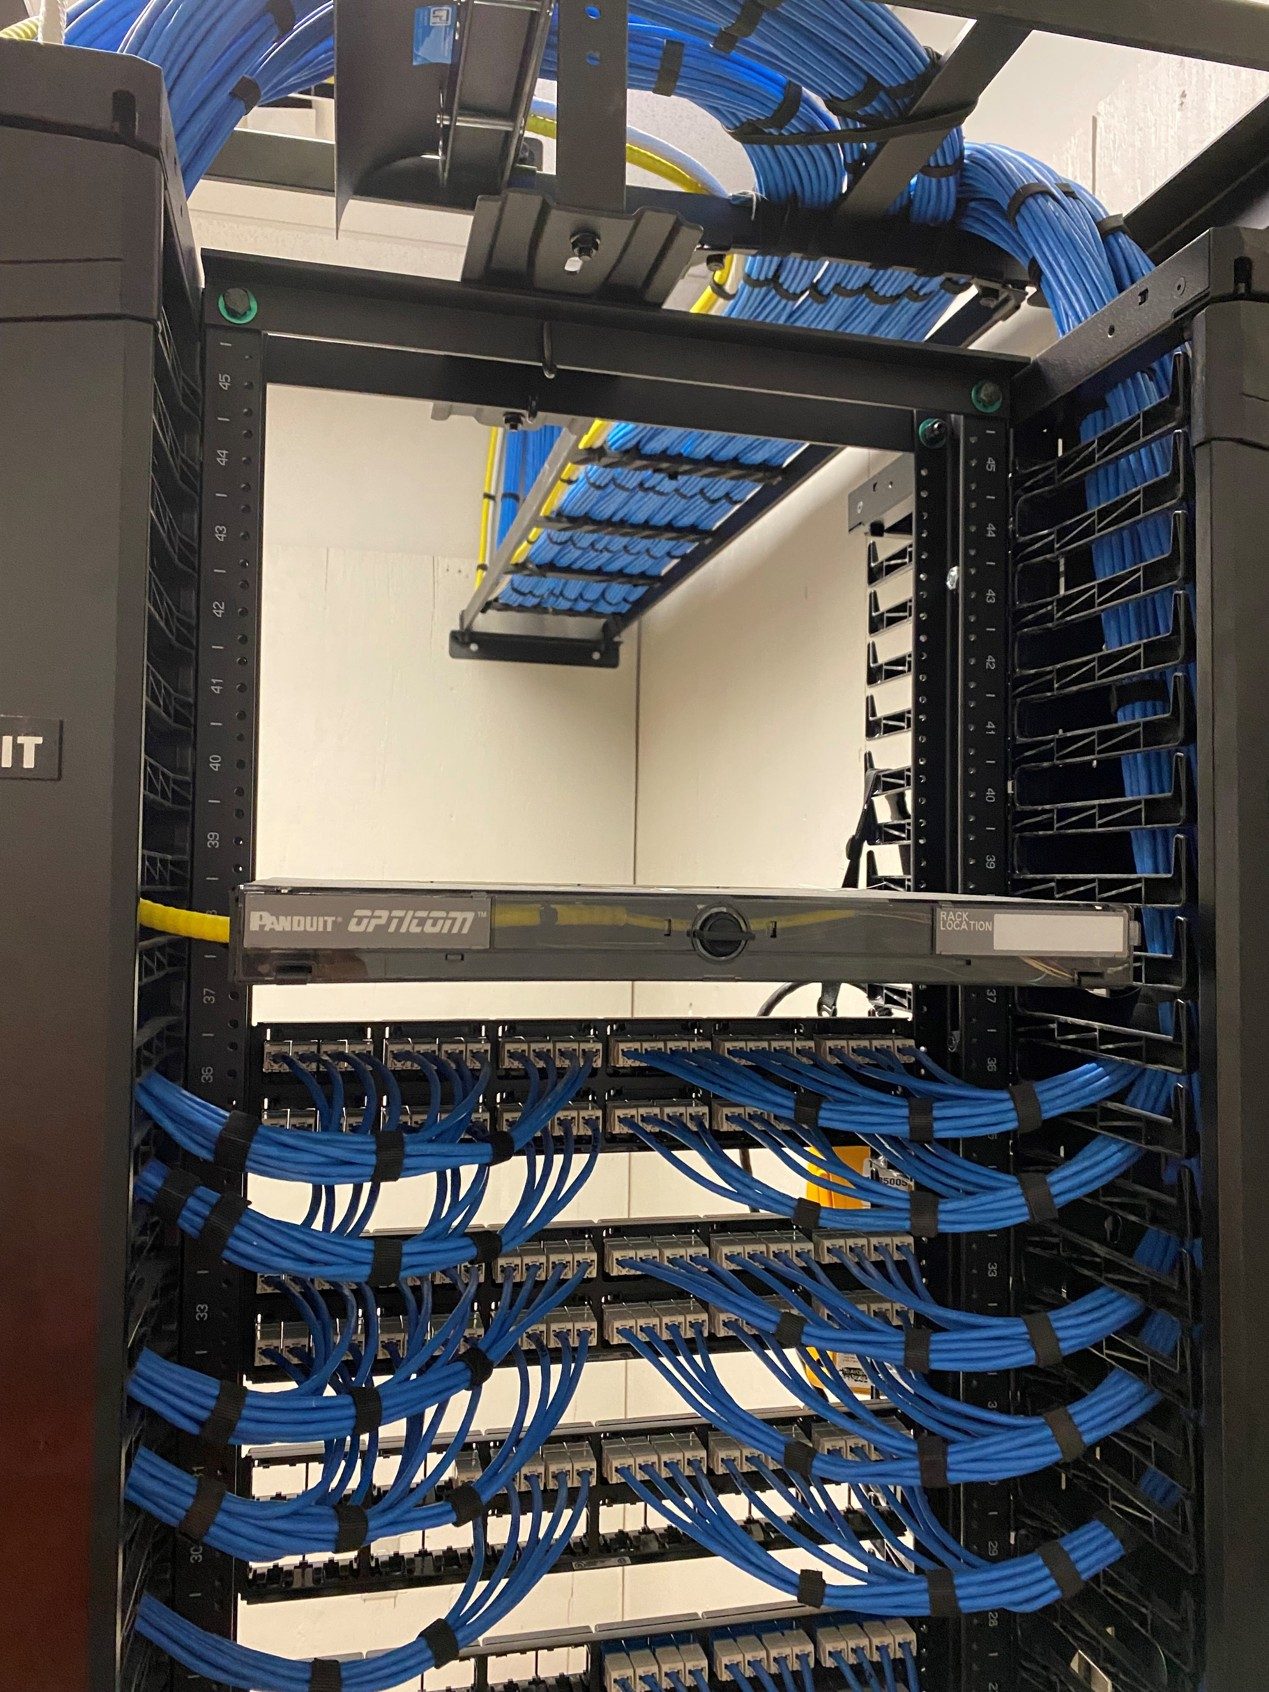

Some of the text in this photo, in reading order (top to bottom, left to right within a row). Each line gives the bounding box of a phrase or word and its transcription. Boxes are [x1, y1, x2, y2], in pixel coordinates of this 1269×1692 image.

[218, 373, 232, 391] 45
[216, 449, 230, 466] 44
[986, 456, 997, 472] 45
[214, 525, 228, 542] 43
[986, 522, 997, 538] 44
[986, 588, 997, 604] 43
[212, 600, 226, 618] 42
[985, 654, 996, 671] 42
[210, 678, 224, 694] 41
[985, 720, 996, 736] 41
[209, 754, 222, 772] 40
[985, 787, 996, 803] 40
[206, 831, 220, 849] 39
[985, 854, 996, 870] 39
[940, 911, 969, 921] RACK
[940, 920, 993, 931] LOCATION
[202, 988, 215, 1004] 37
[986, 988, 997, 1004] 37
[987, 1262, 998, 1277] 33
[195, 1303, 209, 1321] 33
